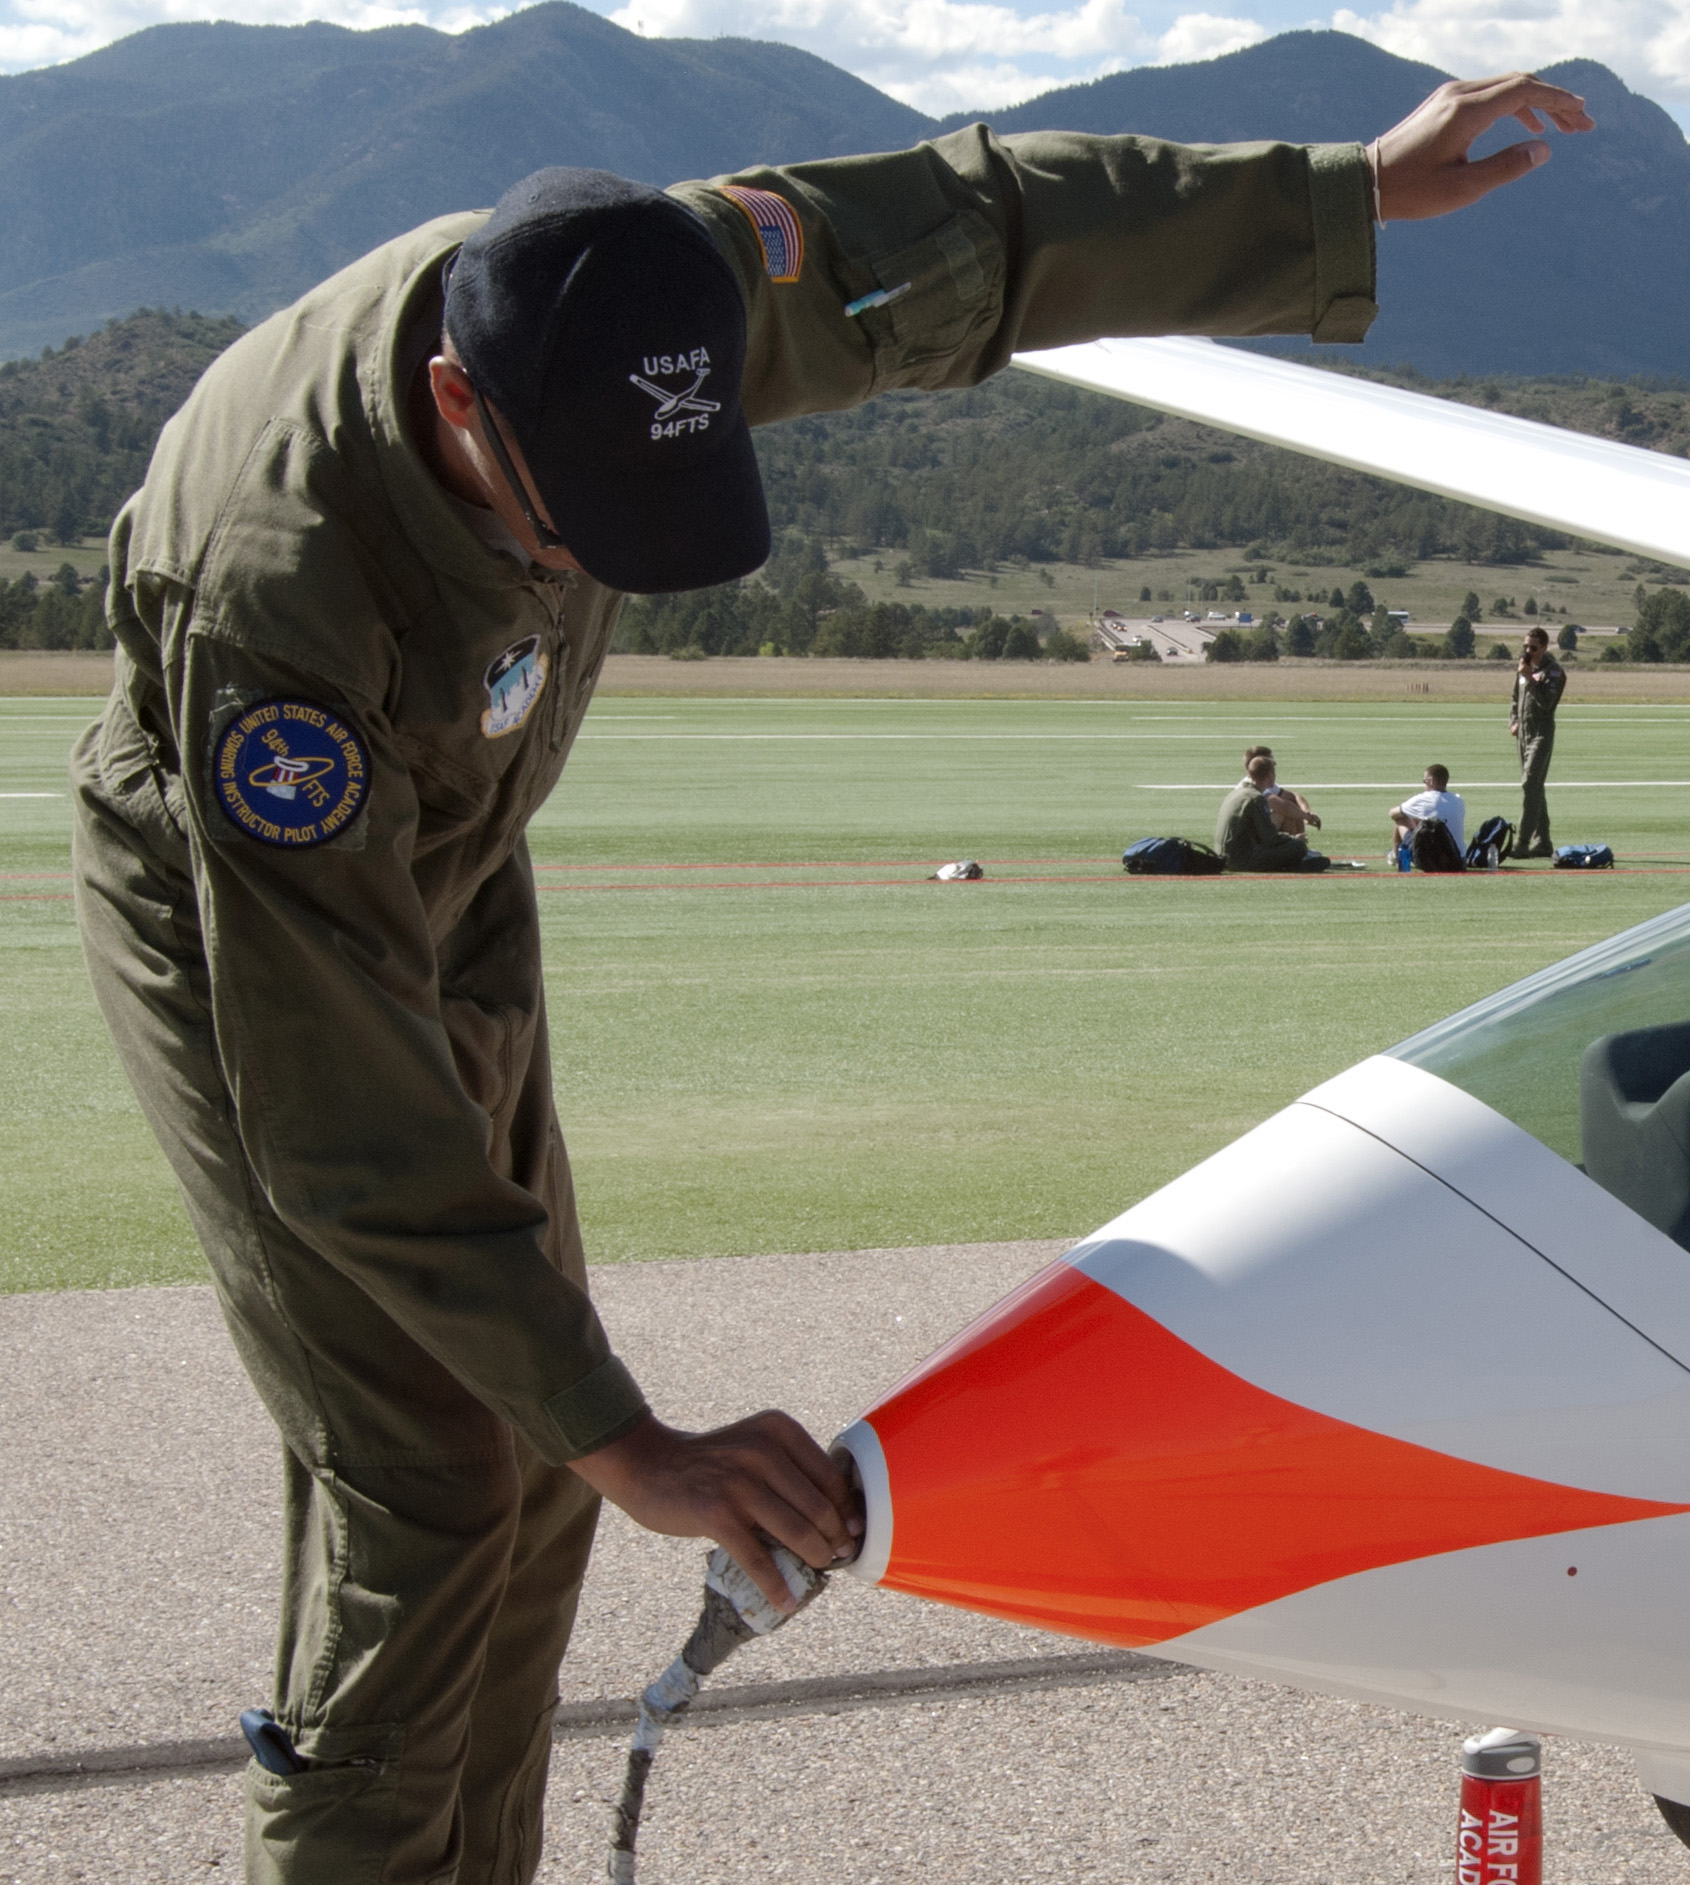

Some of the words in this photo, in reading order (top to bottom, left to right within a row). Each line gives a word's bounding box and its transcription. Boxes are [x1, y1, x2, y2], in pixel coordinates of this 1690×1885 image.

[643, 346, 711, 376] USAFA
[650, 413, 710, 440] 94FTS
[240, 706, 279, 734] UNITED
[283, 704, 327, 728] STATES
[261, 728, 291, 757] 94th
[325, 723, 349, 743] AIR
[220, 731, 244, 779] SOARING
[341, 741, 363, 778] FORCE
[302, 779, 331, 808] FTS
[320, 781, 362, 835] ACADEMY
[222, 781, 281, 840] INSTRUCTOR
[283, 825, 318, 843] PILOT
[1487, 1809, 1519, 1856] AIR
